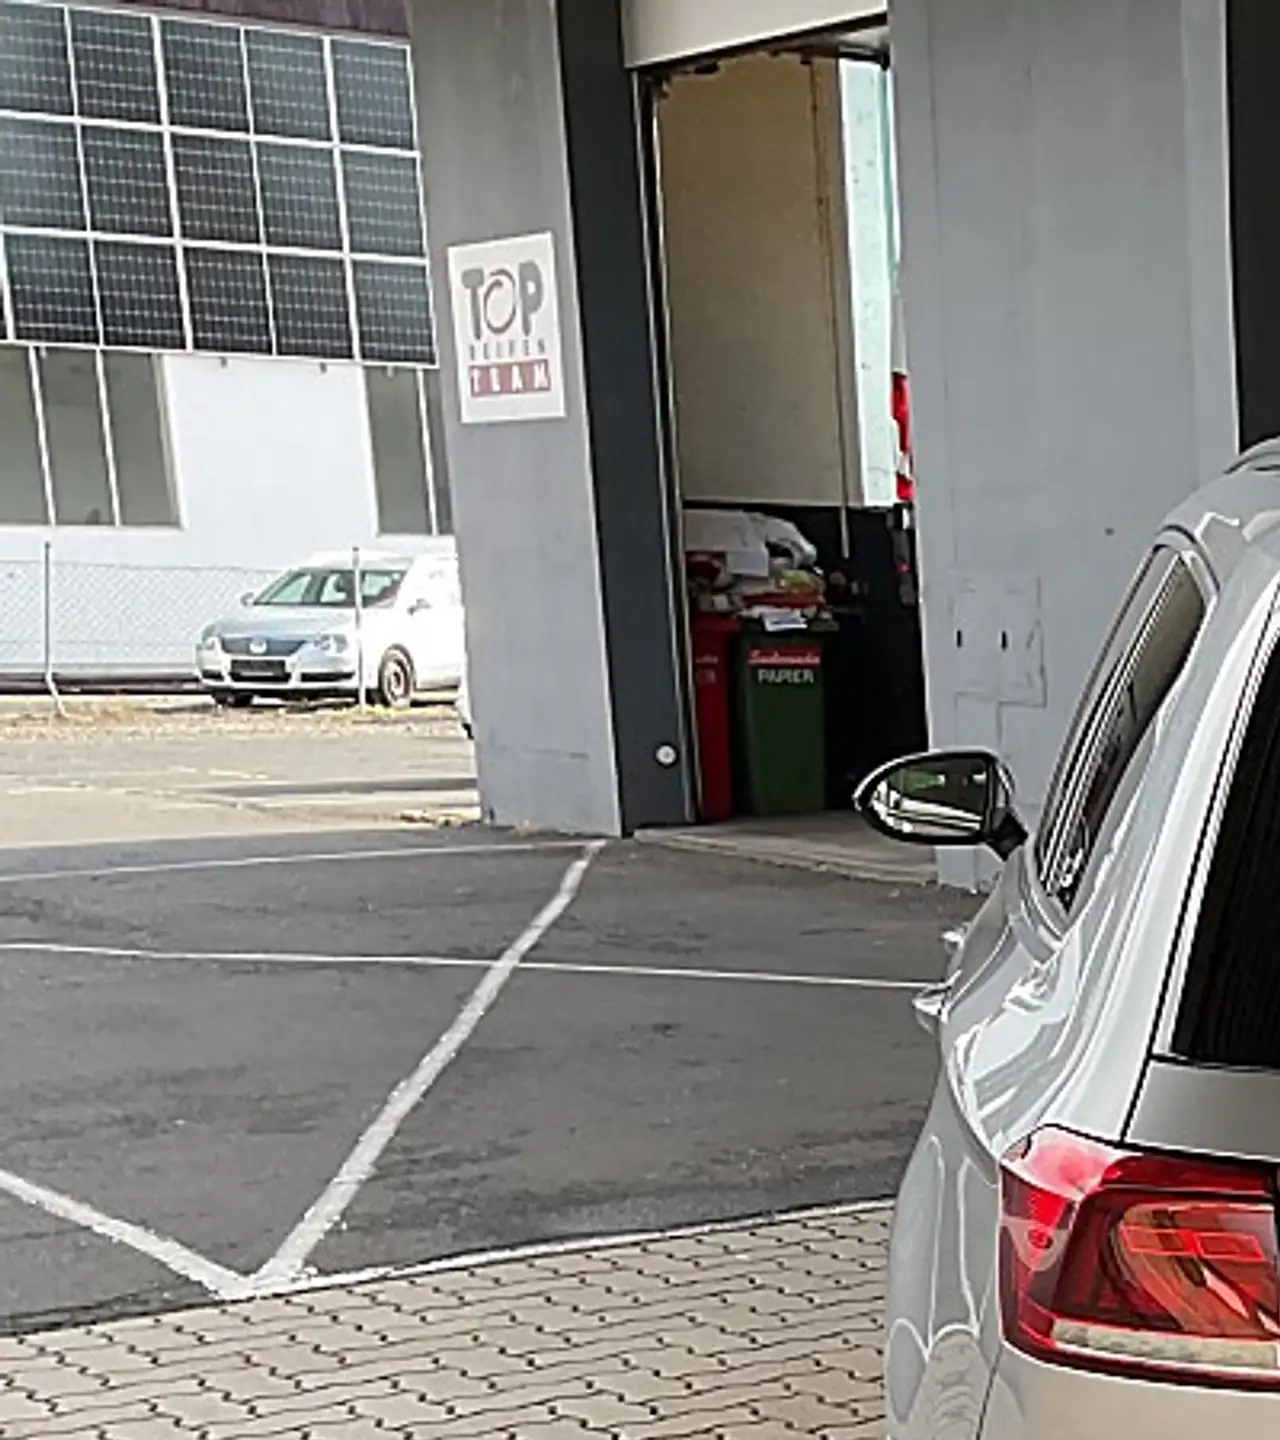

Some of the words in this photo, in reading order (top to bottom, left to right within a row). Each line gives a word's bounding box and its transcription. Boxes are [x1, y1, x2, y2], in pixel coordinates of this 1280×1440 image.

[461, 260, 544, 340] TOP
[472, 363, 549, 393] TEAM
[757, 668, 814, 684] PAPIER
